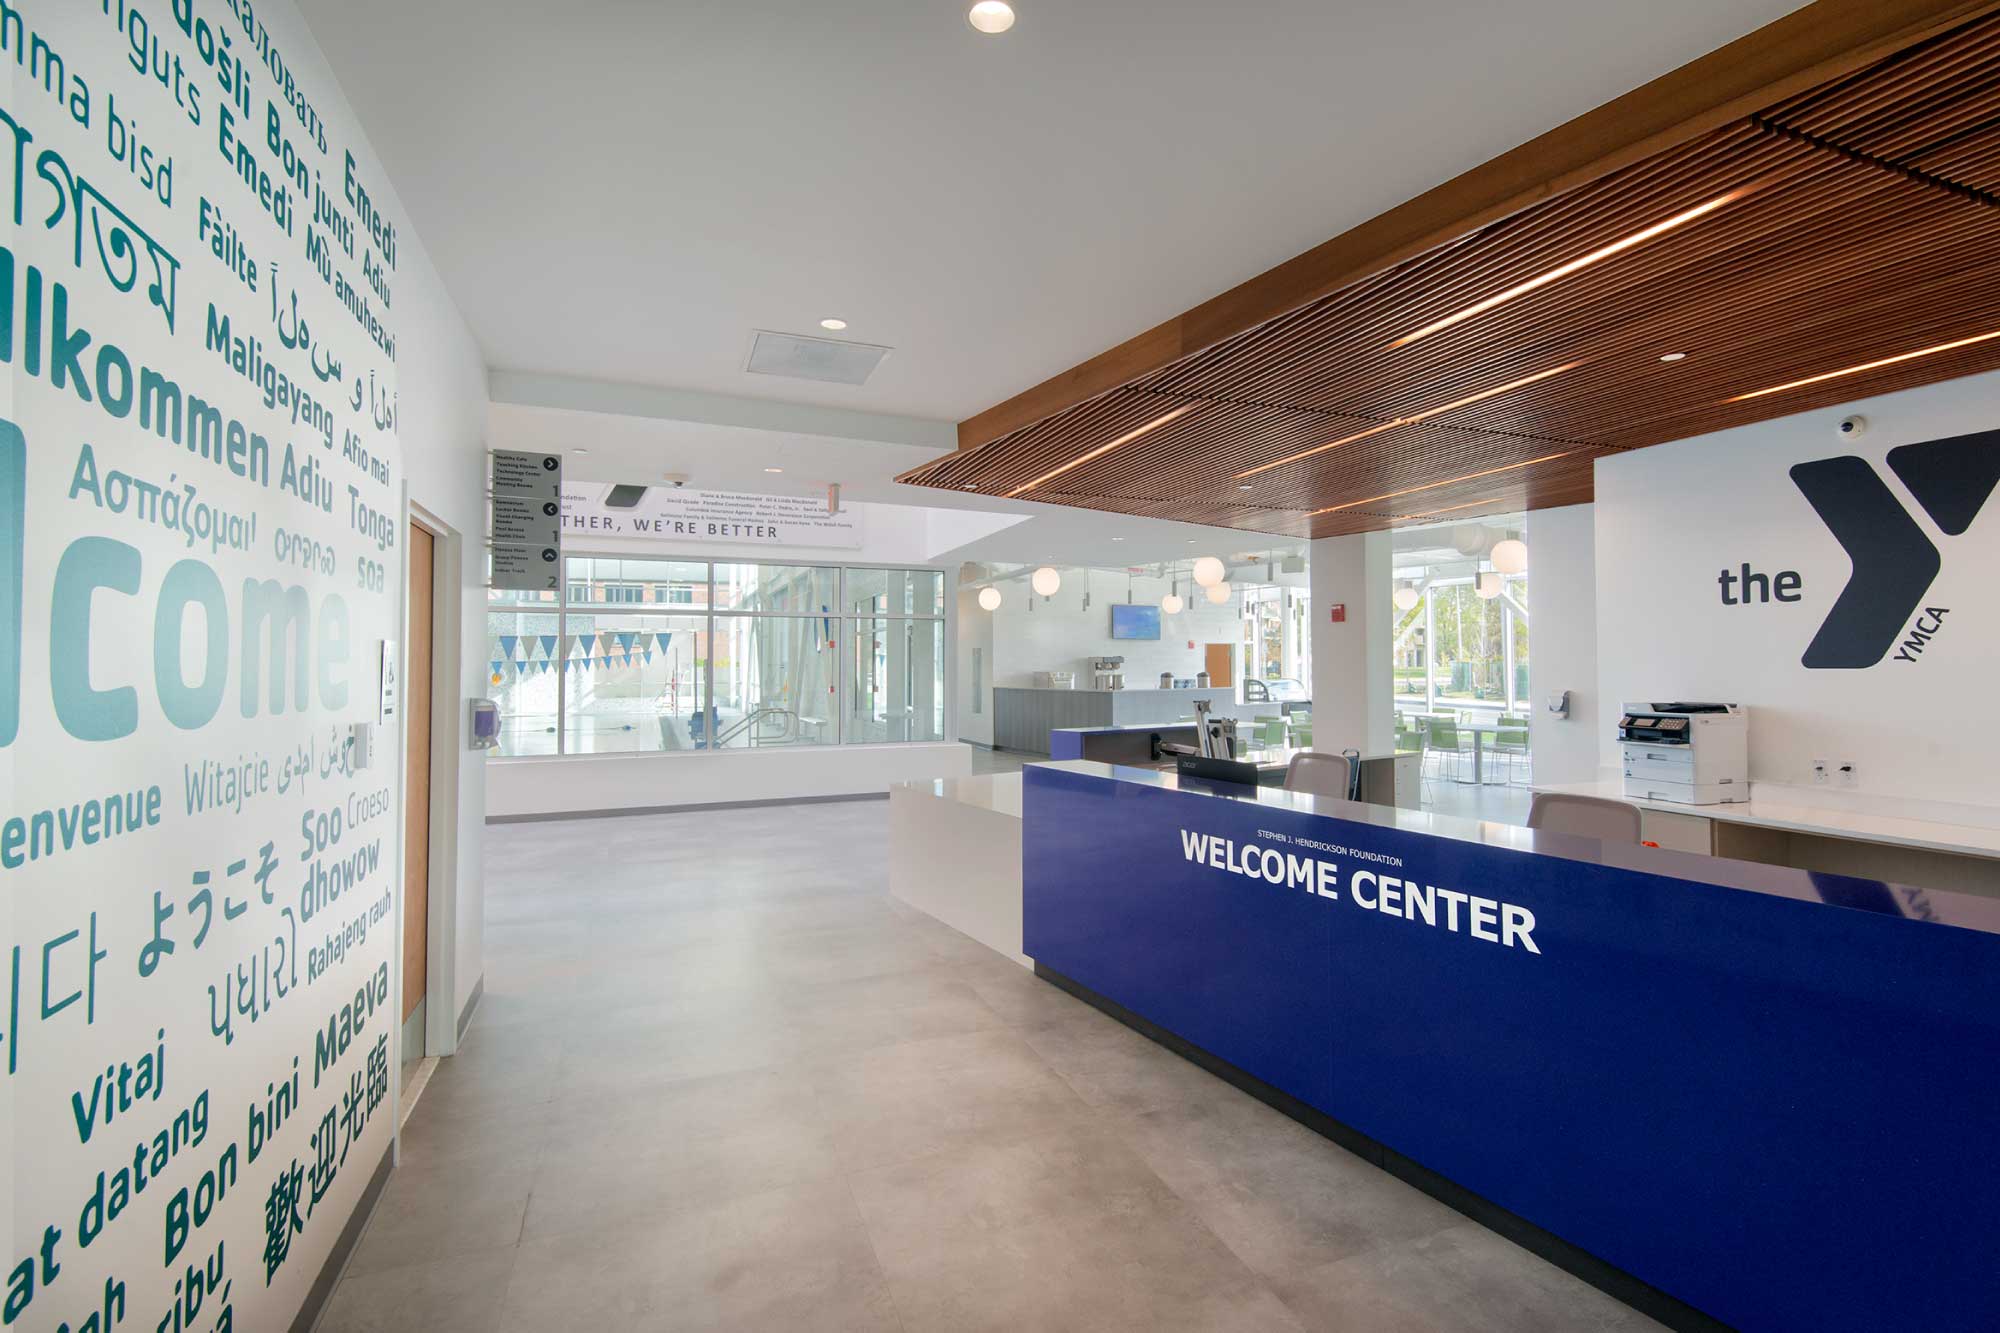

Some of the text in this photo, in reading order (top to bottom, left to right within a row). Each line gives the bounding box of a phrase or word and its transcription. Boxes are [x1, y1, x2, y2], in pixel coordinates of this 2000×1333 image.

[108, 93, 172, 209] bisd
[218, 102, 293, 238] Emedi
[267, 99, 354, 260] Bon junti
[199, 196, 257, 293] Fàilte
[344, 148, 397, 272] Emedi
[362, 247, 391, 309] Adiu
[205, 301, 334, 450] Maligayang
[279, 442, 333, 513] Adiu
[342, 428, 390, 487] Afio mai
[552, 485, 559, 497] 1
[347, 484, 395, 594] Tonga soa
[552, 530, 558, 542] 1
[708, 523, 777, 538] BETTER
[547, 575, 557, 589] 2
[1717, 562, 1802, 606] the
[1893, 604, 1950, 664] YMCA
[184, 751, 270, 816] Witajcie
[347, 787, 390, 830] Croeso
[300, 807, 381, 923] Soo dhowow
[1180, 829, 1542, 955] WELCOME CENTER
[1256, 829, 1403, 868] STEPHEN J. HENDRICKSON FOUNDATION
[138, 840, 279, 978] ようこそ
[307, 884, 392, 986] Rahajeng rauh
[313, 960, 389, 1089] Maeva
[71, 1027, 165, 1145] Vitaj
[77, 1088, 210, 1249] datang
[164, 1055, 299, 1269] Bon bini
